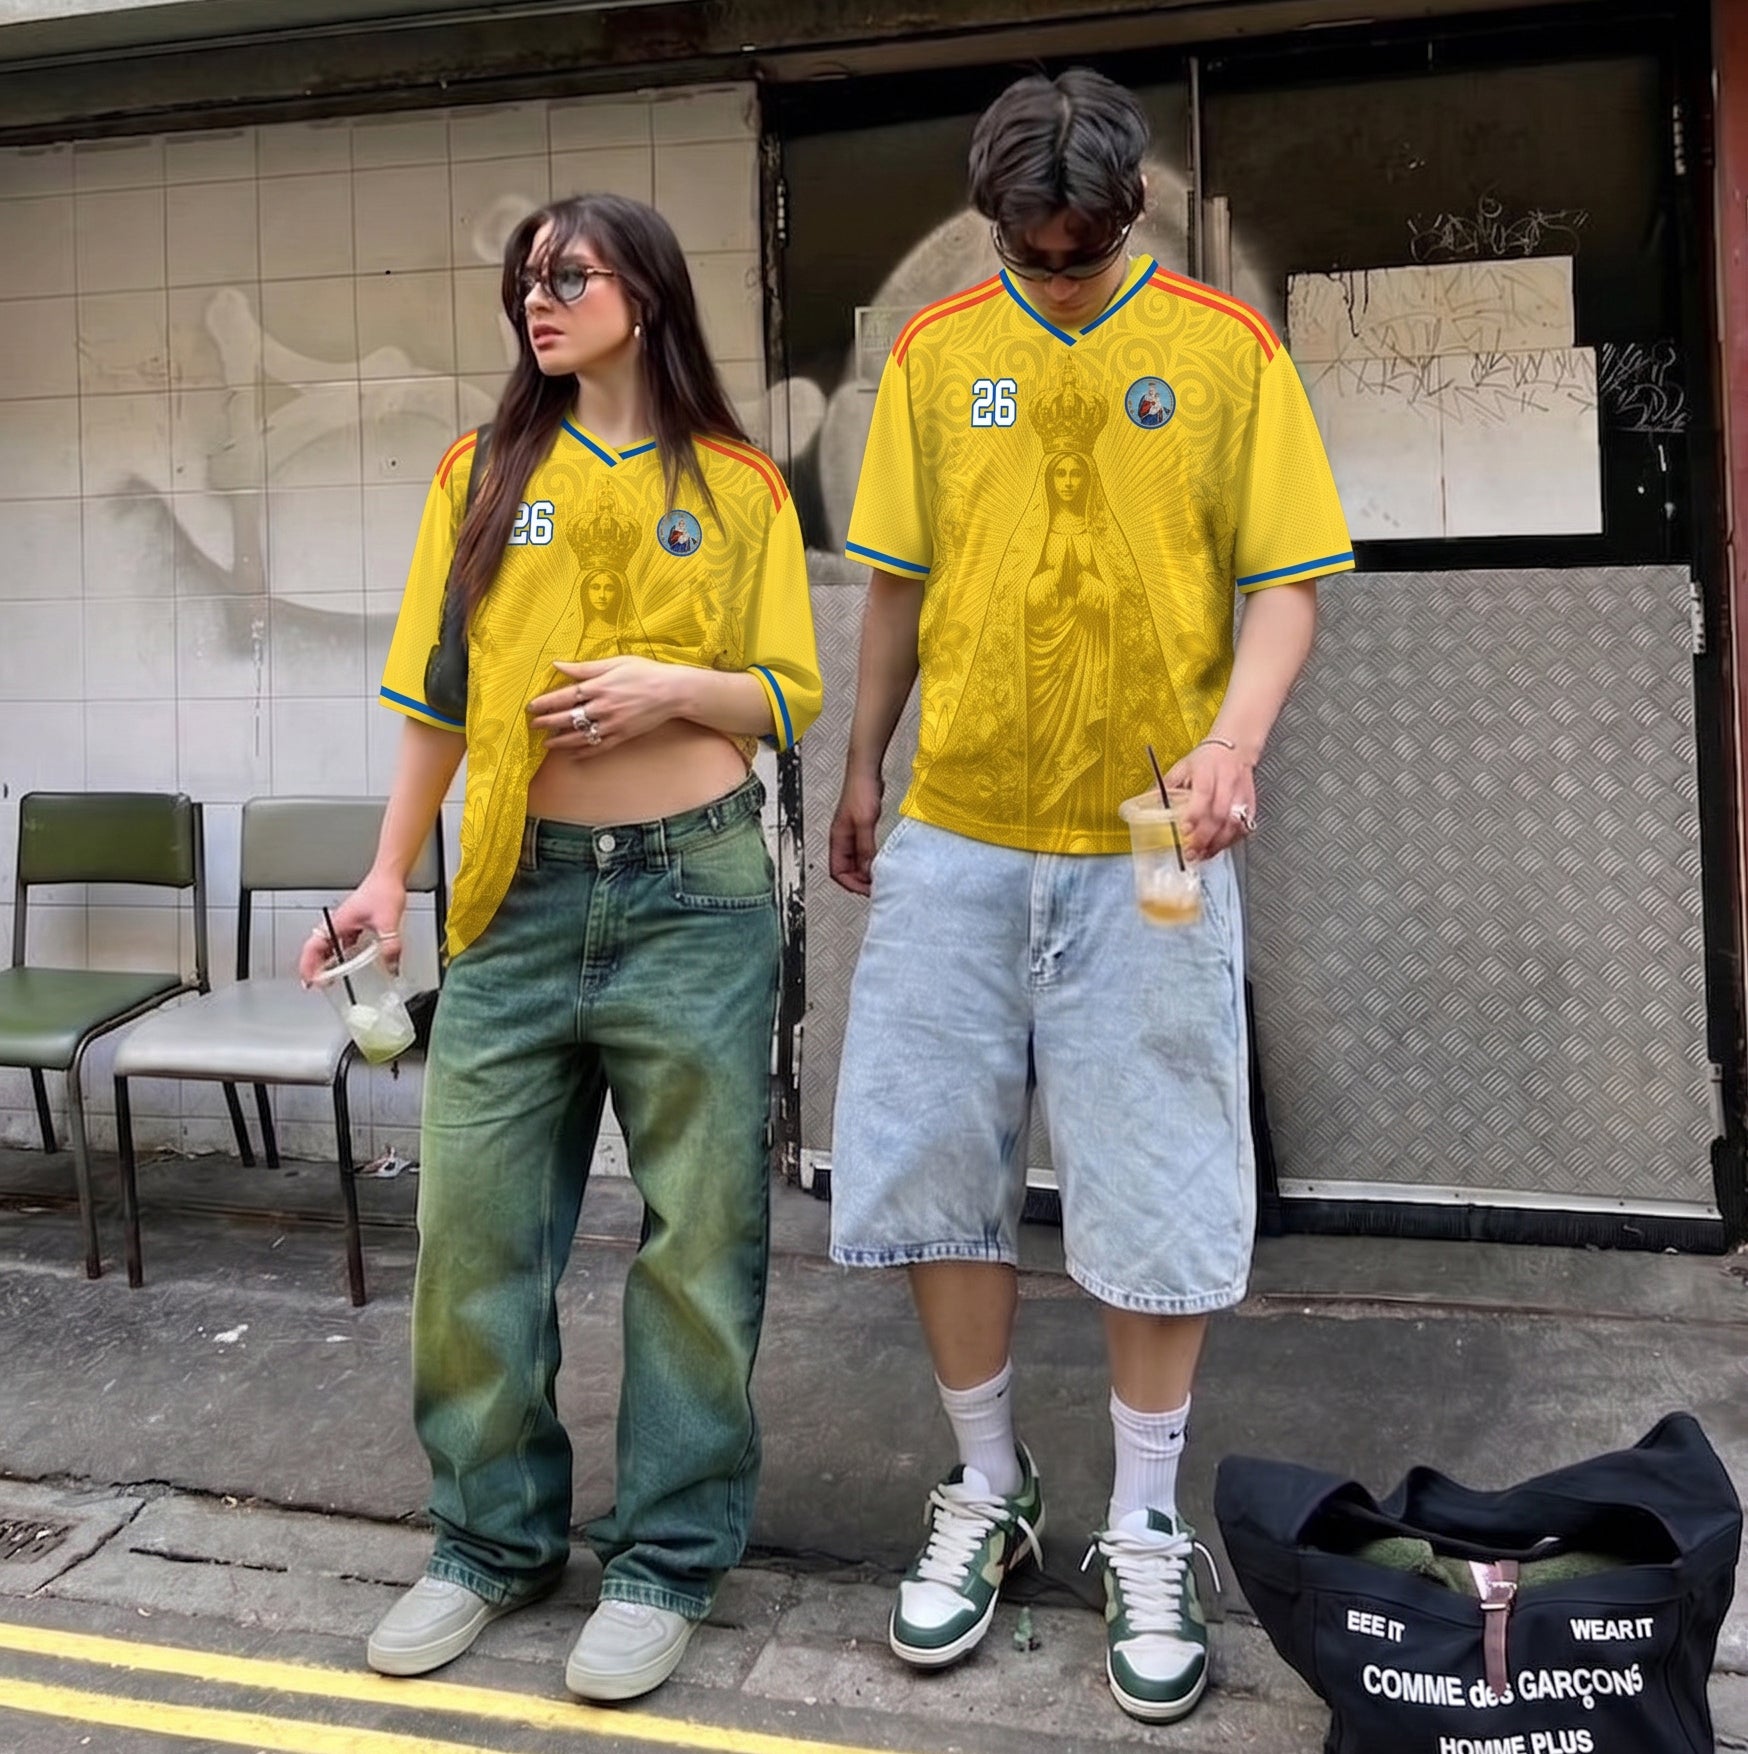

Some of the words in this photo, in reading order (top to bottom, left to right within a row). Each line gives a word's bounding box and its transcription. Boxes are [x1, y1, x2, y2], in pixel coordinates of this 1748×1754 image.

[971, 378, 1018, 427] 26
[508, 500, 555, 545] 26
[1388, 1619, 1406, 1642] IT
[1570, 1619, 1635, 1640] WEAR
[1635, 1617, 1654, 1638] IT
[1363, 1664, 1466, 1706] COMME
[1531, 1729, 1594, 1754] PLUS
